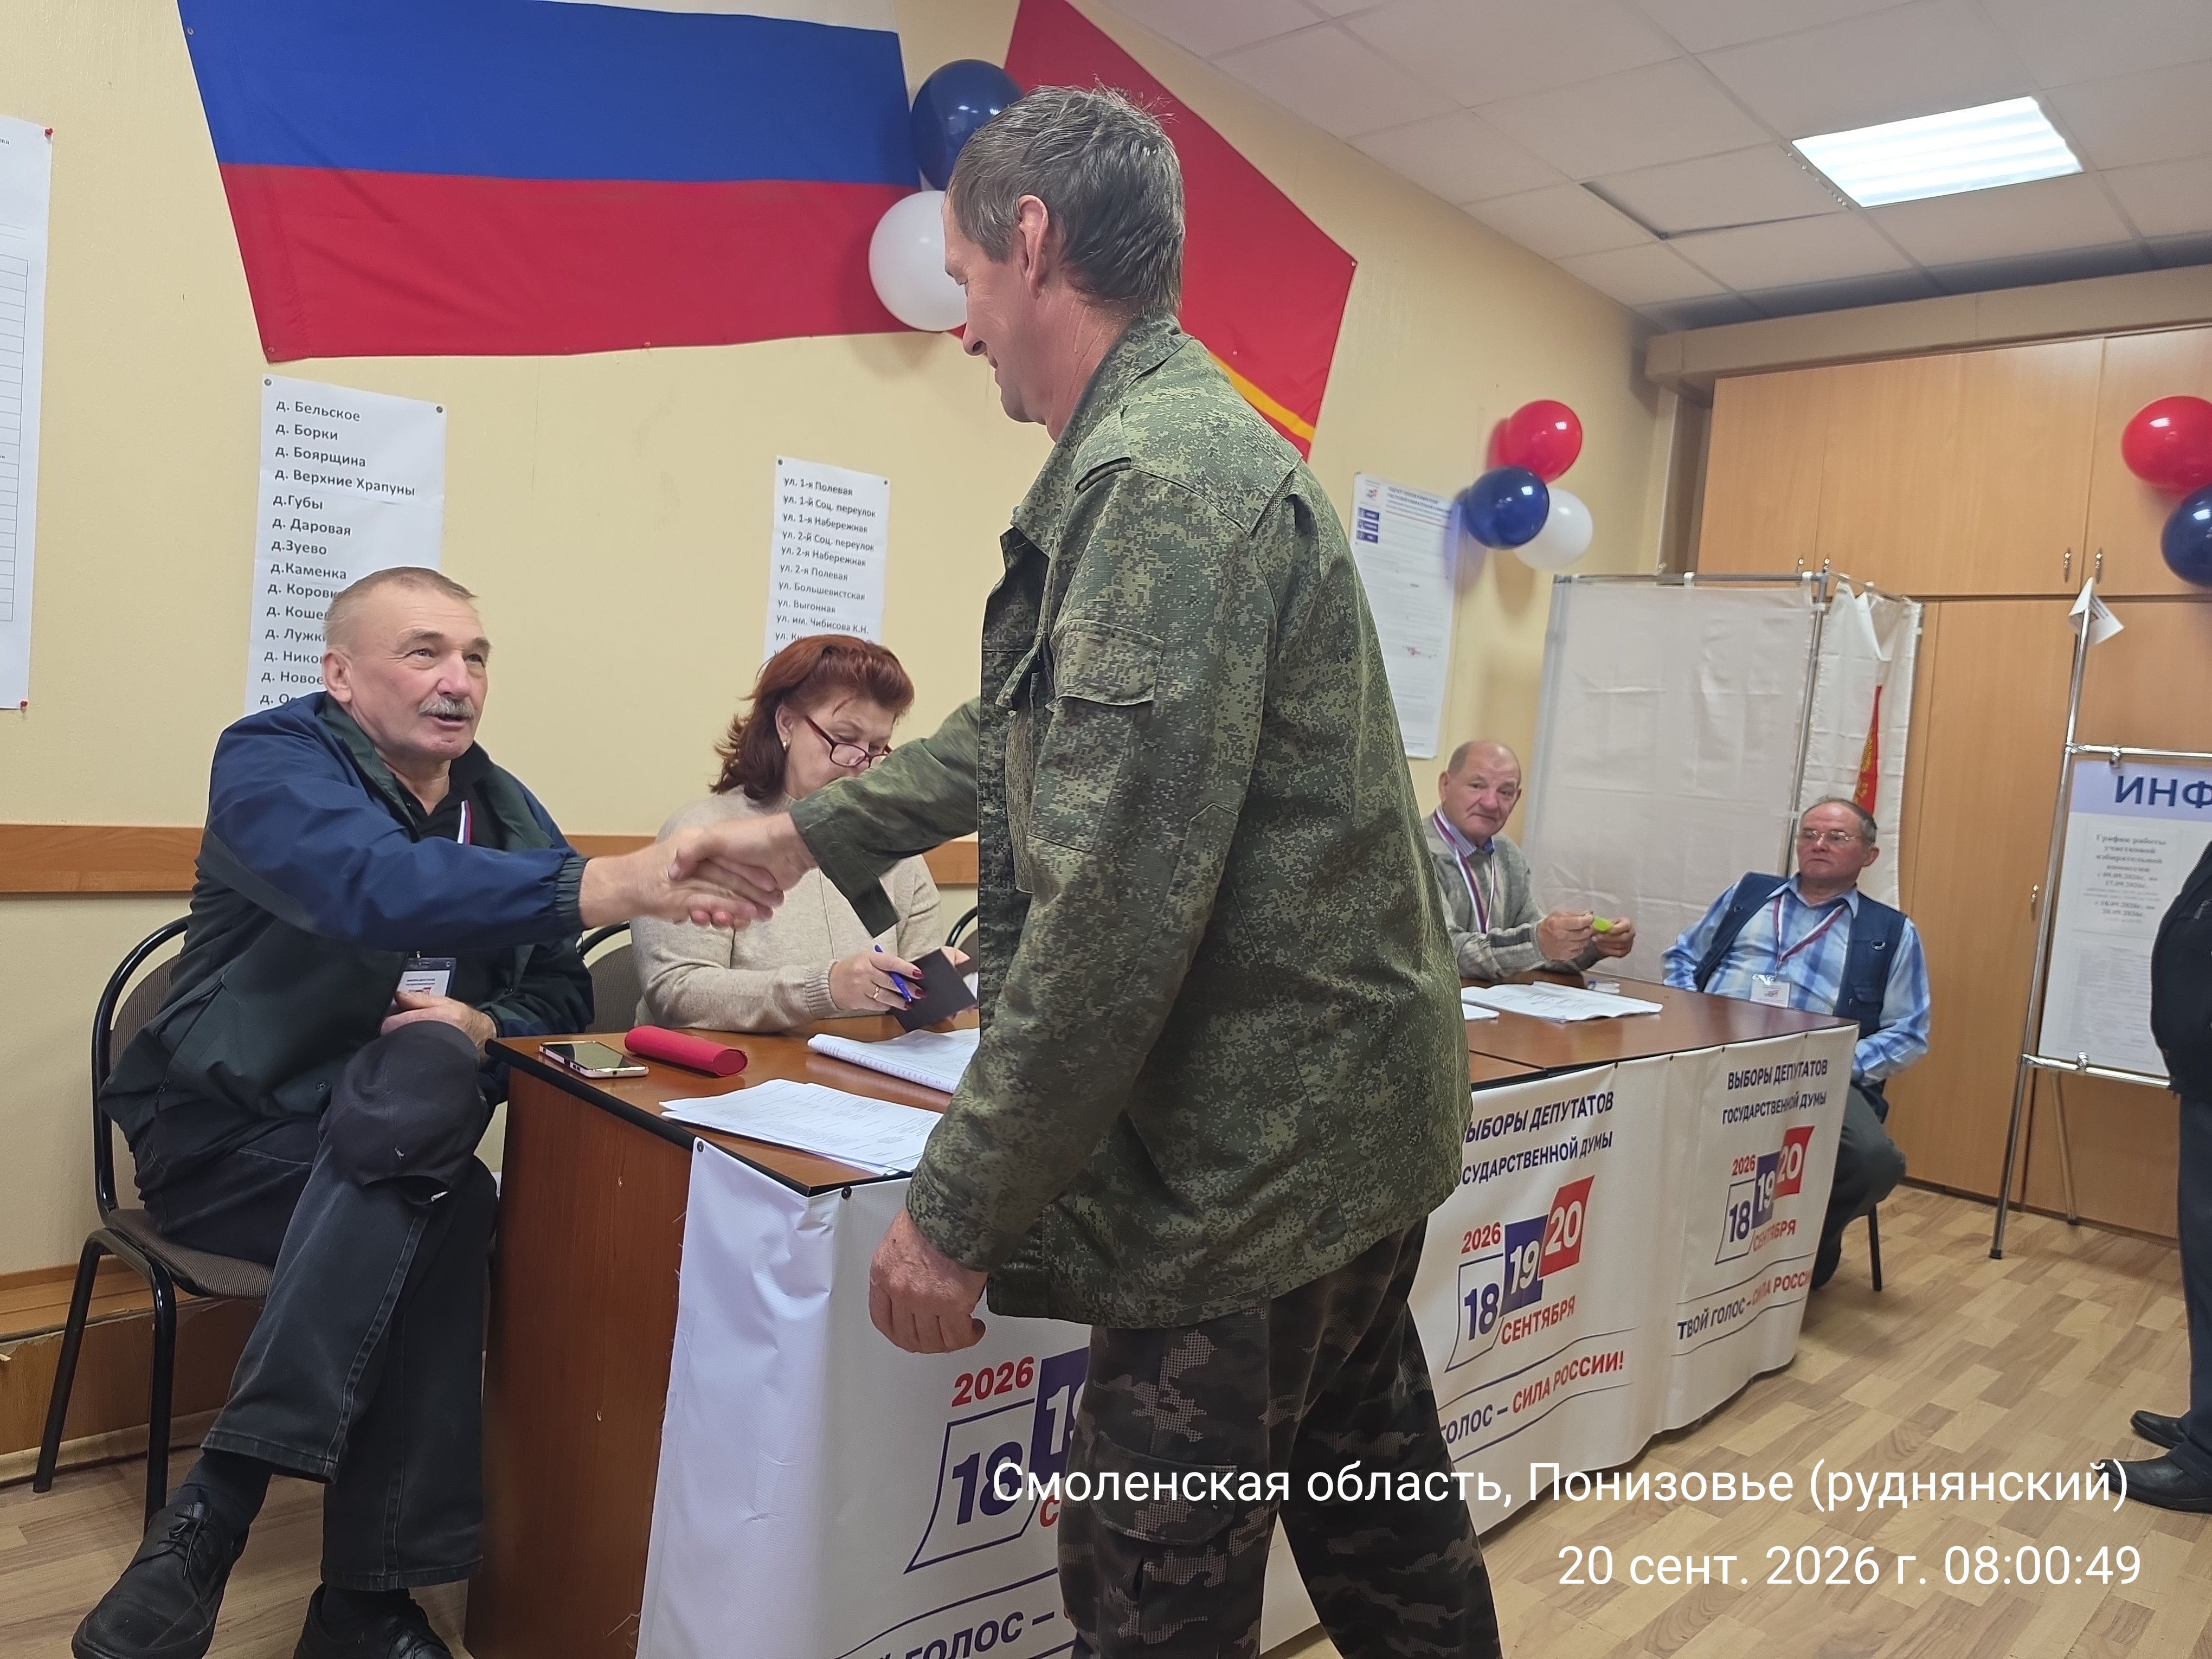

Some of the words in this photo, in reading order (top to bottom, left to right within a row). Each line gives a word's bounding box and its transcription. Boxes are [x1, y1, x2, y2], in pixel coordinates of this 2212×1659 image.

[275, 401, 290, 411] д.
[295, 401, 360, 421] Бельское
[275, 424, 289, 434] д.
[294, 424, 338, 441] Борки
[275, 447, 288, 457] д.
[294, 447, 366, 467] Боярщина
[274, 470, 288, 480] д.
[293, 470, 352, 487] Верхние
[357, 478, 415, 496] Храпуны
[801, 479, 813, 488] 1-я
[815, 481, 853, 496] Полевая
[273, 494, 323, 510] д.Губы
[800, 496, 813, 506] 1-й
[815, 499, 834, 511] Соц.
[837, 505, 876, 518] переулок
[272, 518, 286, 529] д.
[290, 518, 351, 536] Даровая
[799, 514, 812, 524] 1-я
[815, 517, 868, 533] Набережная
[271, 540, 327, 555] д.Зуево
[798, 531, 812, 541] 2-й
[814, 534, 833, 545] Соц.
[835, 539, 874, 551] переулок
[796, 548, 809, 557] 2-я
[813, 550, 866, 567] Набережная
[271, 563, 346, 580] д.Каменка
[795, 565, 809, 575] 2-я
[812, 568, 848, 581] Полевая
[267, 583, 281, 595] д.
[795, 582, 865, 601] Большевистская
[266, 606, 280, 618] д.
[794, 600, 836, 613] Выгонная
[265, 628, 279, 640] д.
[811, 618, 851, 631] Чибисова
[853, 624, 869, 634] К.Н.
[264, 651, 278, 662] д.
[283, 651, 322, 664] Нико
[261, 672, 275, 683] д.
[260, 695, 274, 705] д.
[1727, 1068, 1772, 1090] ВЫБОРЫ
[1773, 1059, 1828, 1085] ДЕПУТАТОВ
[1465, 1109, 1528, 1143] ЫБОРЫ
[1529, 1091, 1613, 1133] ДЕПУТАТОВ
[1722, 1091, 1798, 1124] ГОСУДАРСТВЕННОЙ
[1799, 1091, 1827, 1110] ДУМЫ
[1462, 1136, 1578, 1185] СУДАРСТВЕННОЙ
[1579, 1131, 1613, 1159] ДУМЫ
[1732, 1154, 1756, 1176] 2026
[1729, 1200, 1750, 1242] 18
[1758, 1170, 1776, 1212] 19
[1777, 1142, 1803, 1183] 20
[1461, 1222, 1501, 1254] 2026
[1464, 1283, 1499, 1341] 18
[1510, 1240, 1540, 1295] 19
[1545, 1200, 1582, 1256] 20
[1501, 1295, 1576, 1345] СЕНТЯБРЯ
[1677, 1307, 1709, 1340] ТВОЙ
[1710, 1297, 1745, 1327] ГОЛОС
[951, 1356, 1034, 1407] 2026
[1441, 1404, 1493, 1444] ОЛОС
[1512, 1377, 1550, 1413] СИЛА
[1553, 1351, 1624, 1392] РОССИИ!
[952, 1441, 1023, 1526] 18
